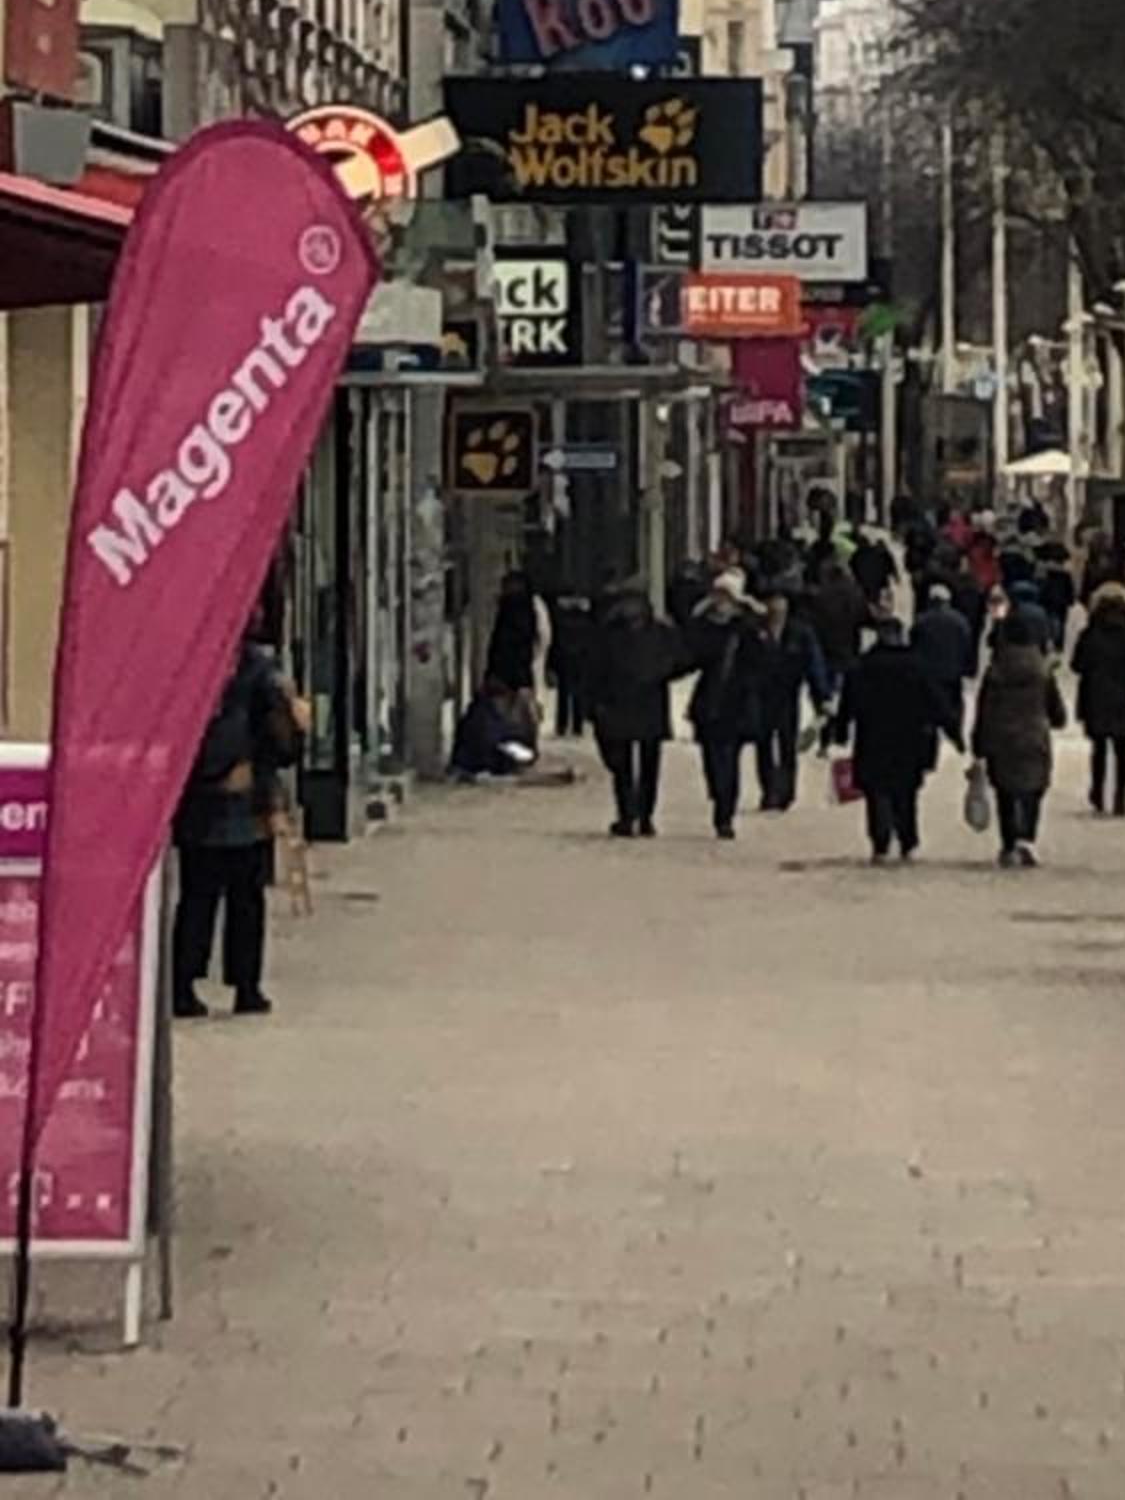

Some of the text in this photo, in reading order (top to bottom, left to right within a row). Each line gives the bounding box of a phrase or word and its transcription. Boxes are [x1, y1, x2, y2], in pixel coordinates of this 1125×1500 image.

[509, 103, 616, 144] Jack
[510, 146, 698, 189] Wolfskin
[705, 233, 844, 261] TISSOT
[497, 266, 559, 309] ck
[687, 286, 781, 312] EITER
[499, 318, 568, 355] RK
[87, 284, 337, 587] Magenta
